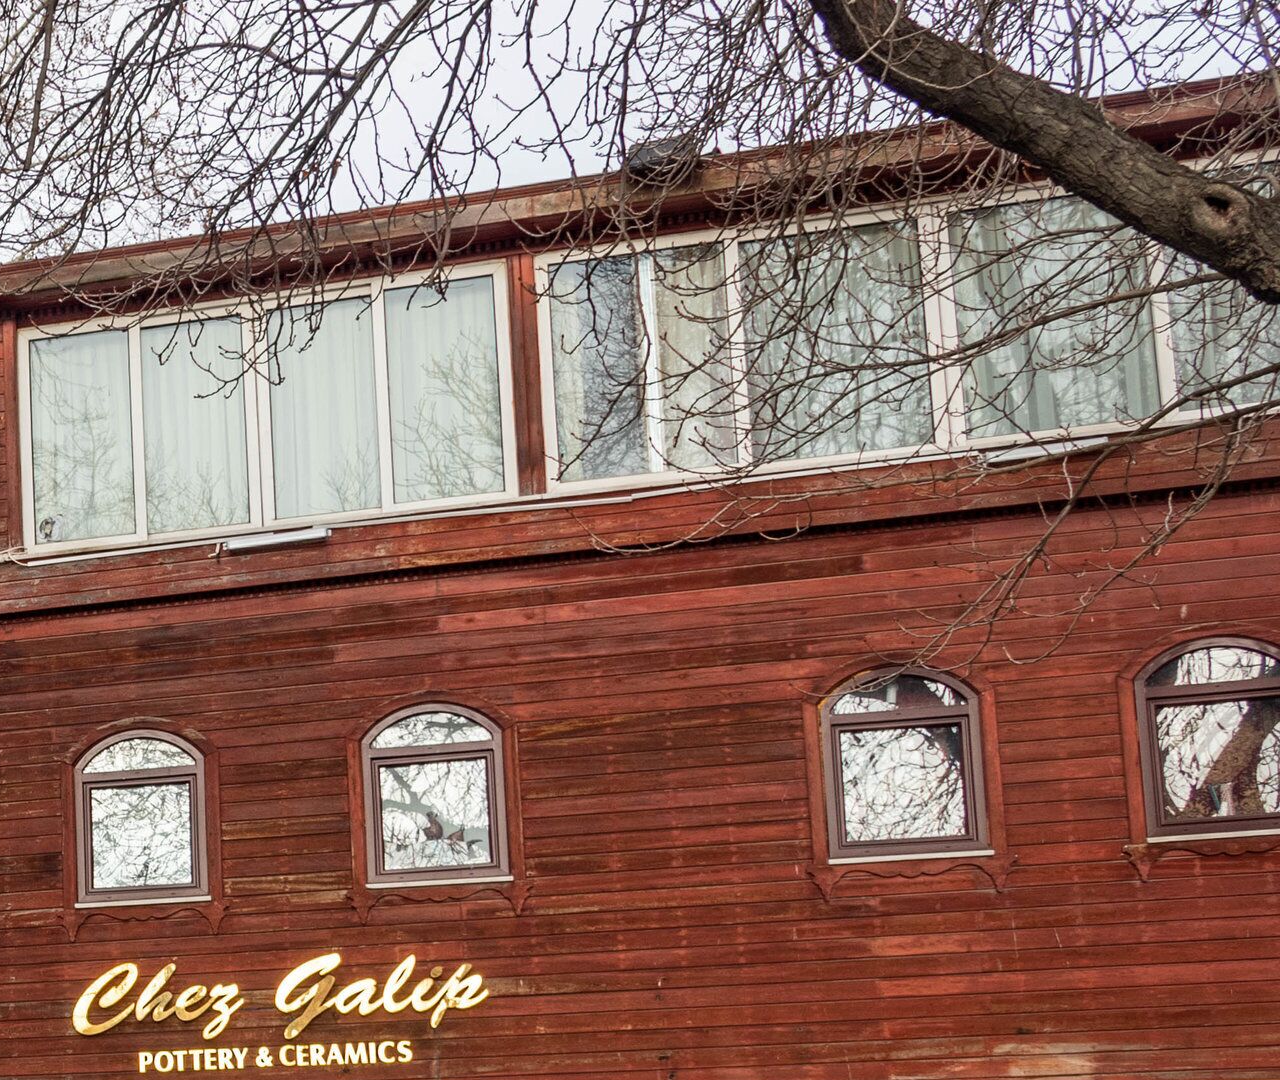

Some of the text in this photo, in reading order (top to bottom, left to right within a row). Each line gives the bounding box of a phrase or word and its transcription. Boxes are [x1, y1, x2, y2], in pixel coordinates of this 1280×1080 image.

[72, 953, 489, 1040] Chez Galip
[138, 1040, 414, 1074] POTTERY & CERAMICS
